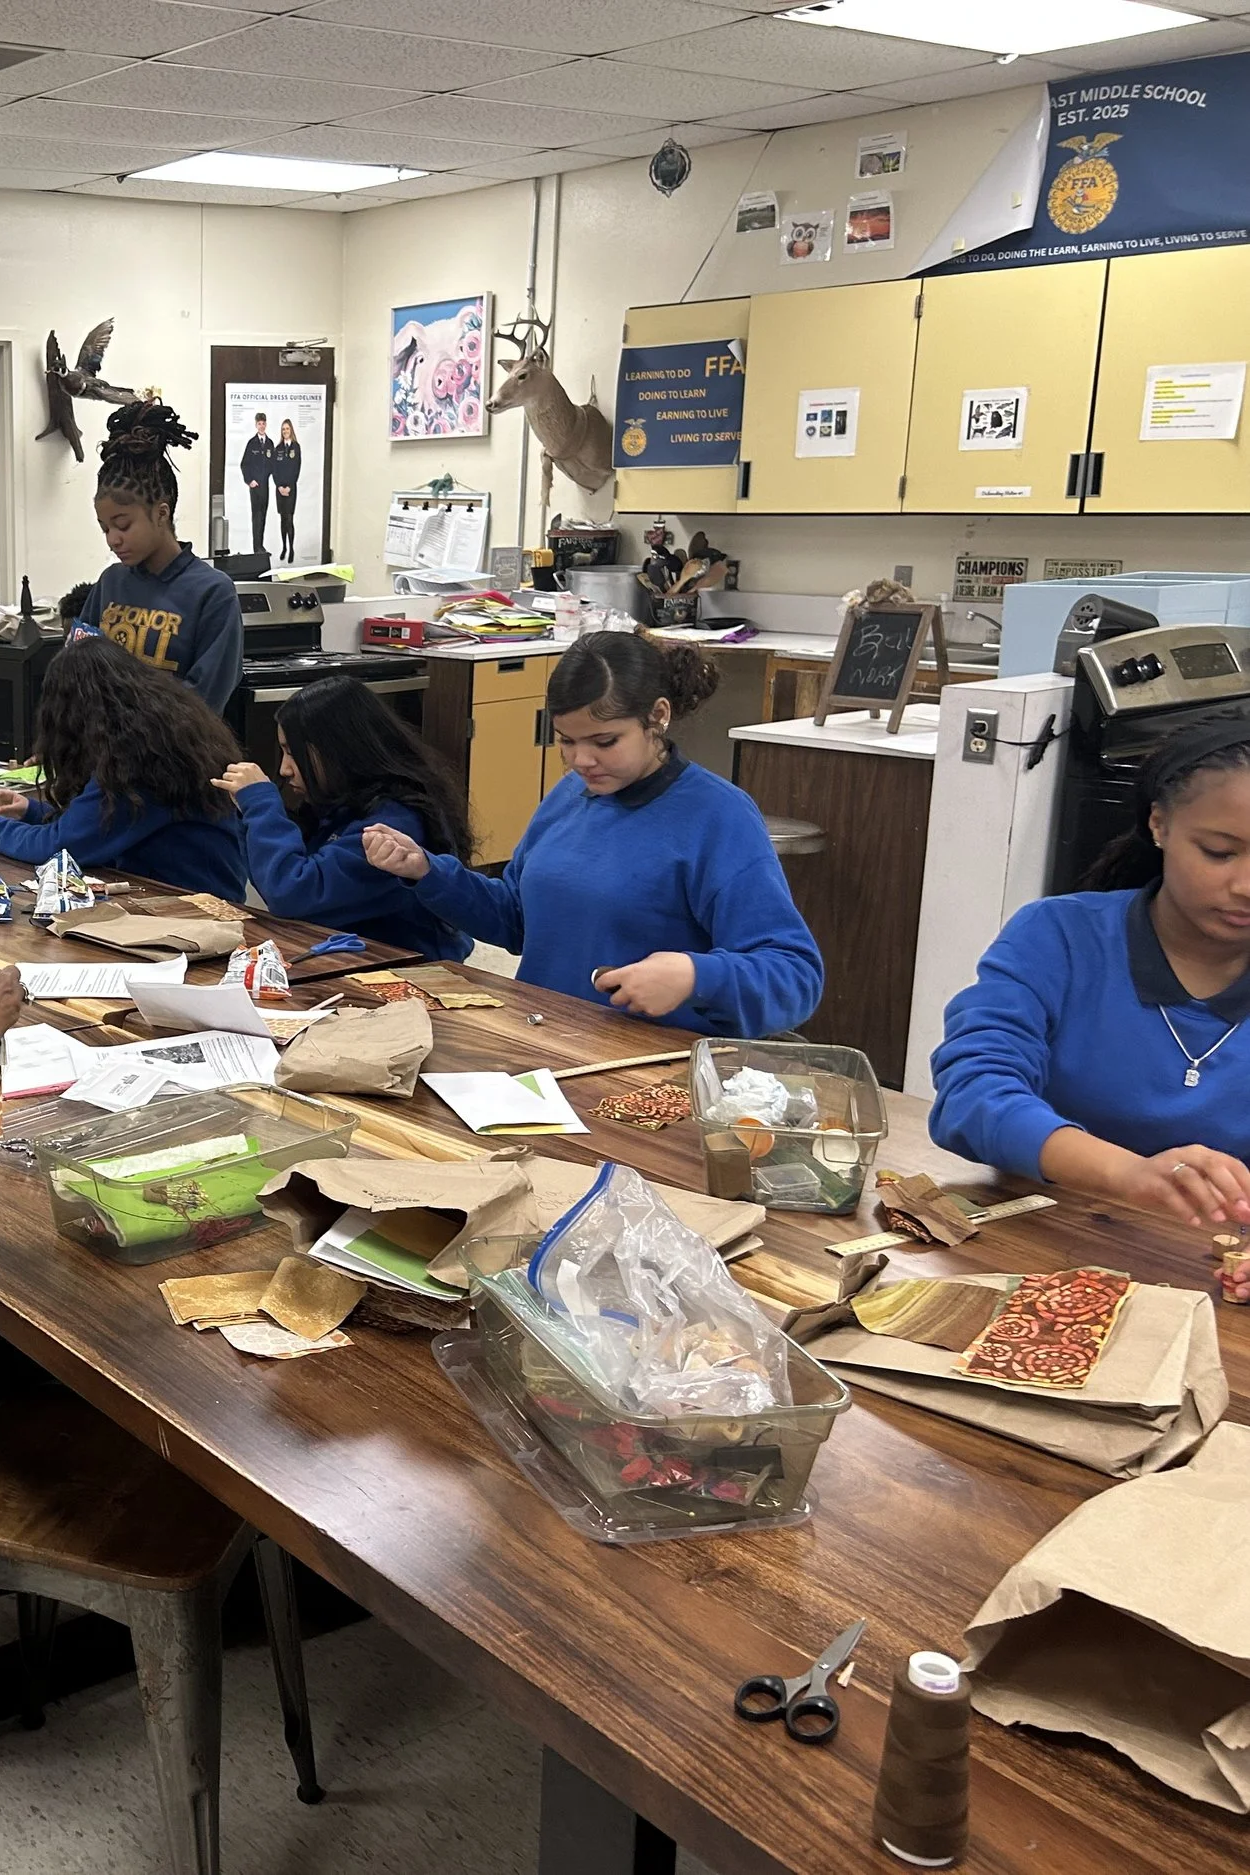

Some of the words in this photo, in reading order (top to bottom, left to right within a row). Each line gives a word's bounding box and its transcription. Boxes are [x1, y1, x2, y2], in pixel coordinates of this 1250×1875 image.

[1079, 84, 1141, 104] MIDDLE
[1143, 84, 1207, 108] SCHOOL
[1057, 108, 1089, 127] EST.
[1092, 104, 1130, 120] 2025
[1071, 176, 1098, 190] FFA
[968, 254, 980, 264] TO
[981, 252, 997, 263] DO,
[998, 249, 1027, 261] DOING
[1029, 248, 1047, 258] THE
[1048, 245, 1081, 257] LEARN,
[1081, 240, 1124, 253] EARNING
[1124, 239, 1138, 249] TO
[1139, 237, 1164, 248] LIVE,
[1165, 234, 1199, 246] LIVING
[1200, 232, 1214, 242] TO
[1215, 229, 1248, 241] SERVE
[705, 355, 745, 378] FFA
[625, 370, 666, 382] LEARNING
[666, 370, 675, 379] TO
[677, 368, 691, 379] DO
[638, 390, 667, 401] DOING
[668, 390, 678, 400] TO
[680, 388, 707, 399] LEARN
[656, 410, 695, 421] EARNING
[696, 409, 707, 418] TO
[708, 408, 729, 418] LIVE
[670, 433, 700, 443] LIVING
[701, 433, 712, 442] TO
[714, 431, 742, 442] SERVE
[957, 560, 1024, 576] CHAMPIONS
[107, 602, 182, 636] HONOR
